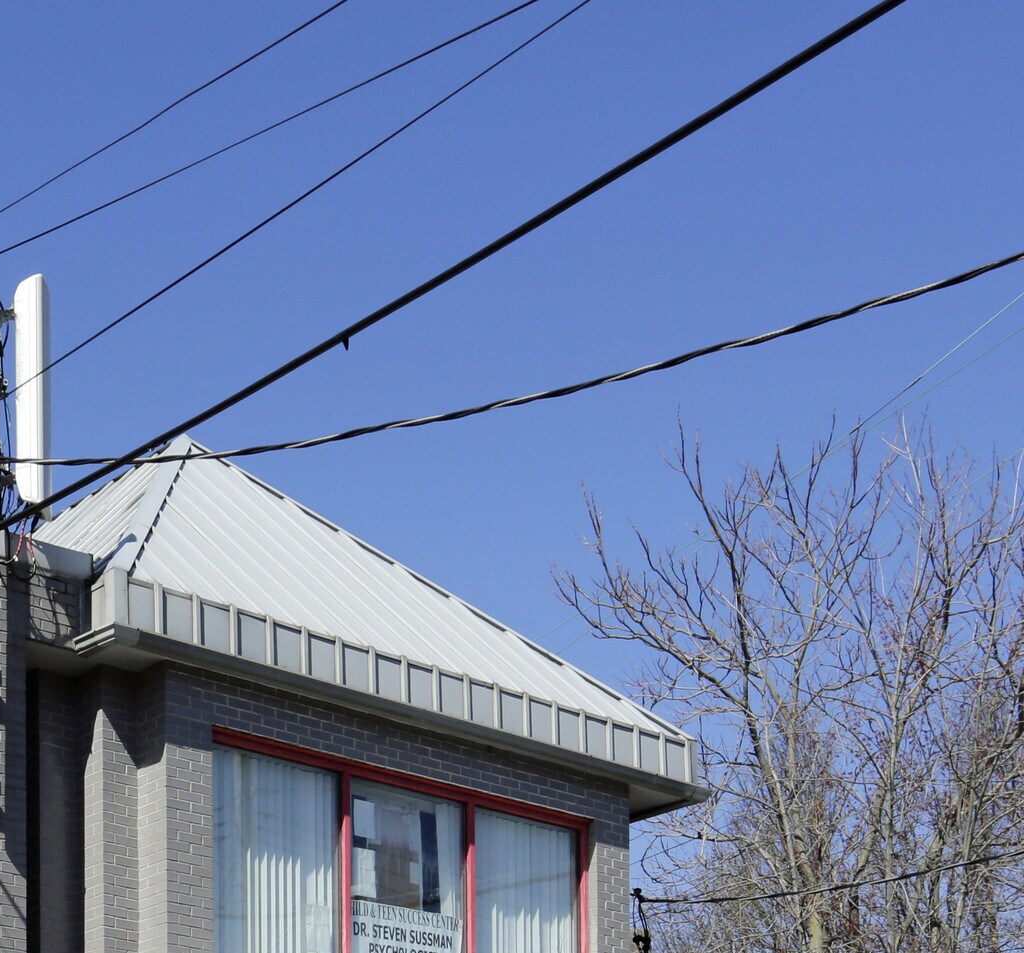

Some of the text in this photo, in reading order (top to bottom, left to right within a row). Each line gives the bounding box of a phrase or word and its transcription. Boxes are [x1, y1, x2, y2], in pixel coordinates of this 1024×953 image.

[370, 905, 376, 918] &
[377, 904, 397, 921] TEEN
[399, 907, 430, 927] SUCCESS
[431, 913, 459, 932] CENTER
[353, 921, 453, 950] DR. STEVEN SUSSMAN
